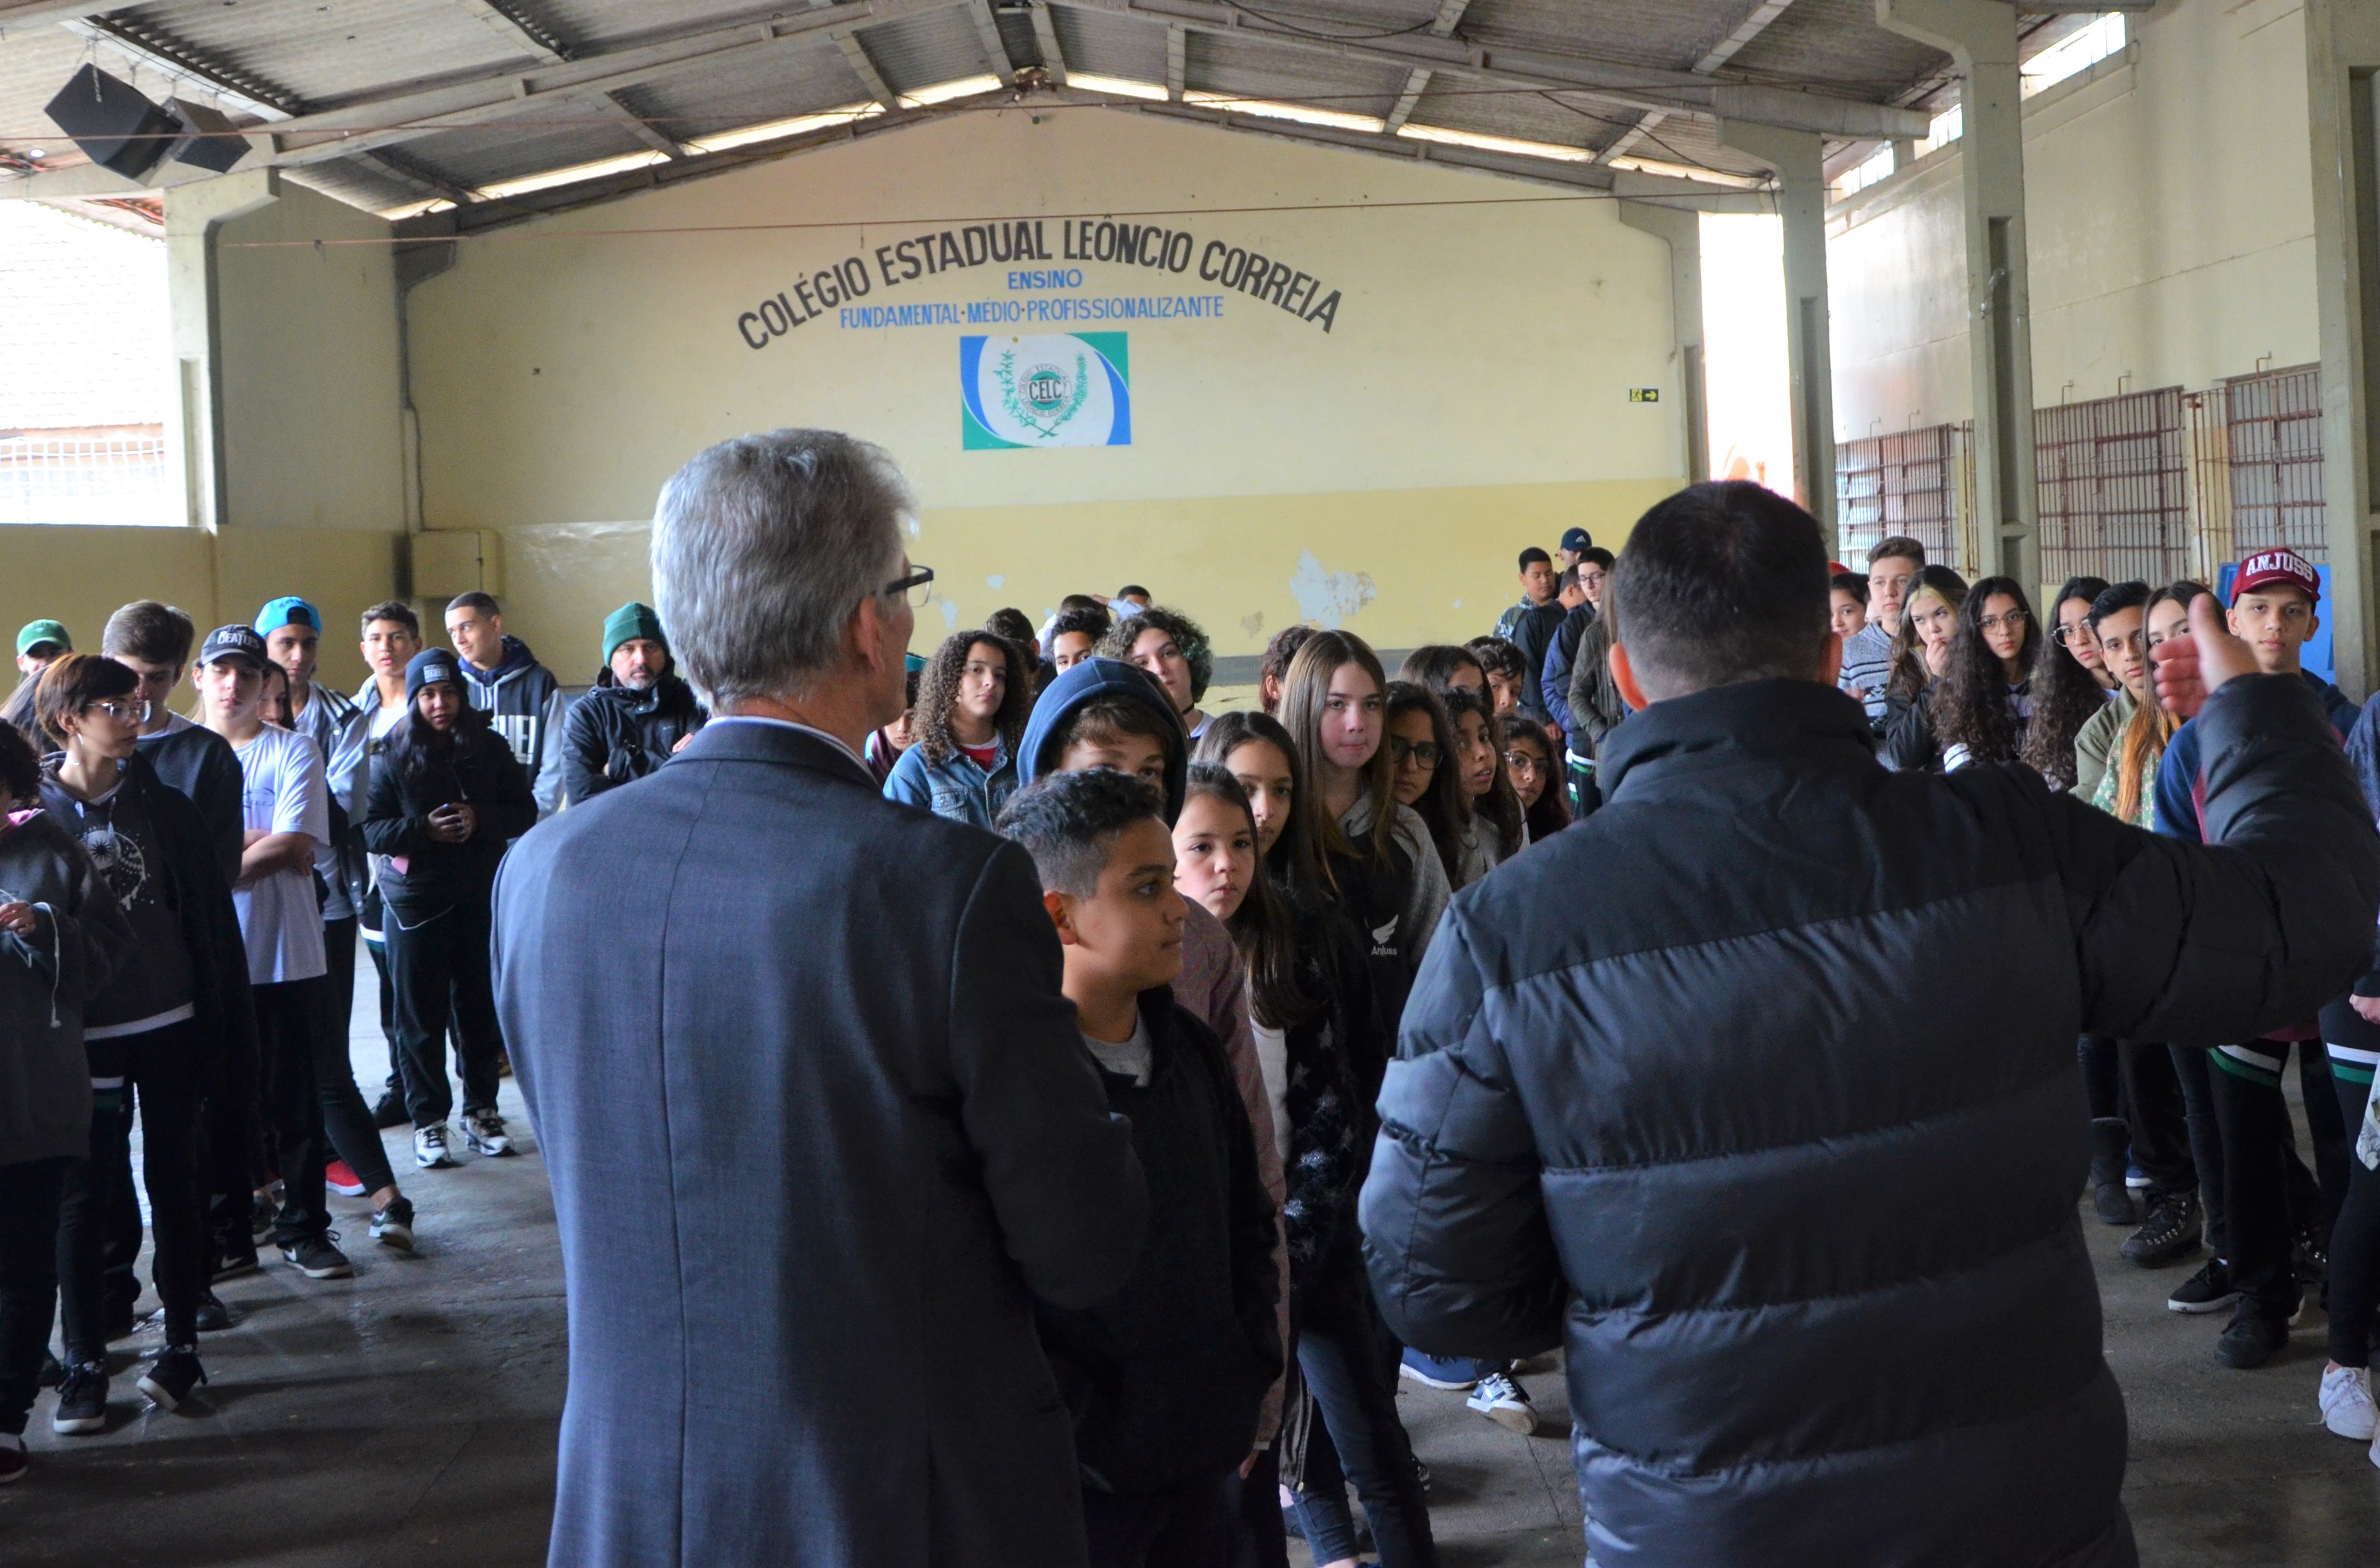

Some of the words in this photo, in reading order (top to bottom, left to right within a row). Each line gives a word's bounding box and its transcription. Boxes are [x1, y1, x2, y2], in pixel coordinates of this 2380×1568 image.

[738, 257, 871, 349] COLÉGIO
[875, 221, 1052, 286] ESTADUAL
[1064, 215, 1193, 273] LEÔNCIO
[1199, 240, 1342, 334] CORREIA
[1008, 269, 1083, 290] ENSINO
[1029, 380, 1062, 400] CELC
[2246, 552, 2313, 582] ANJUSS
[217, 630, 259, 649] BEATLES
